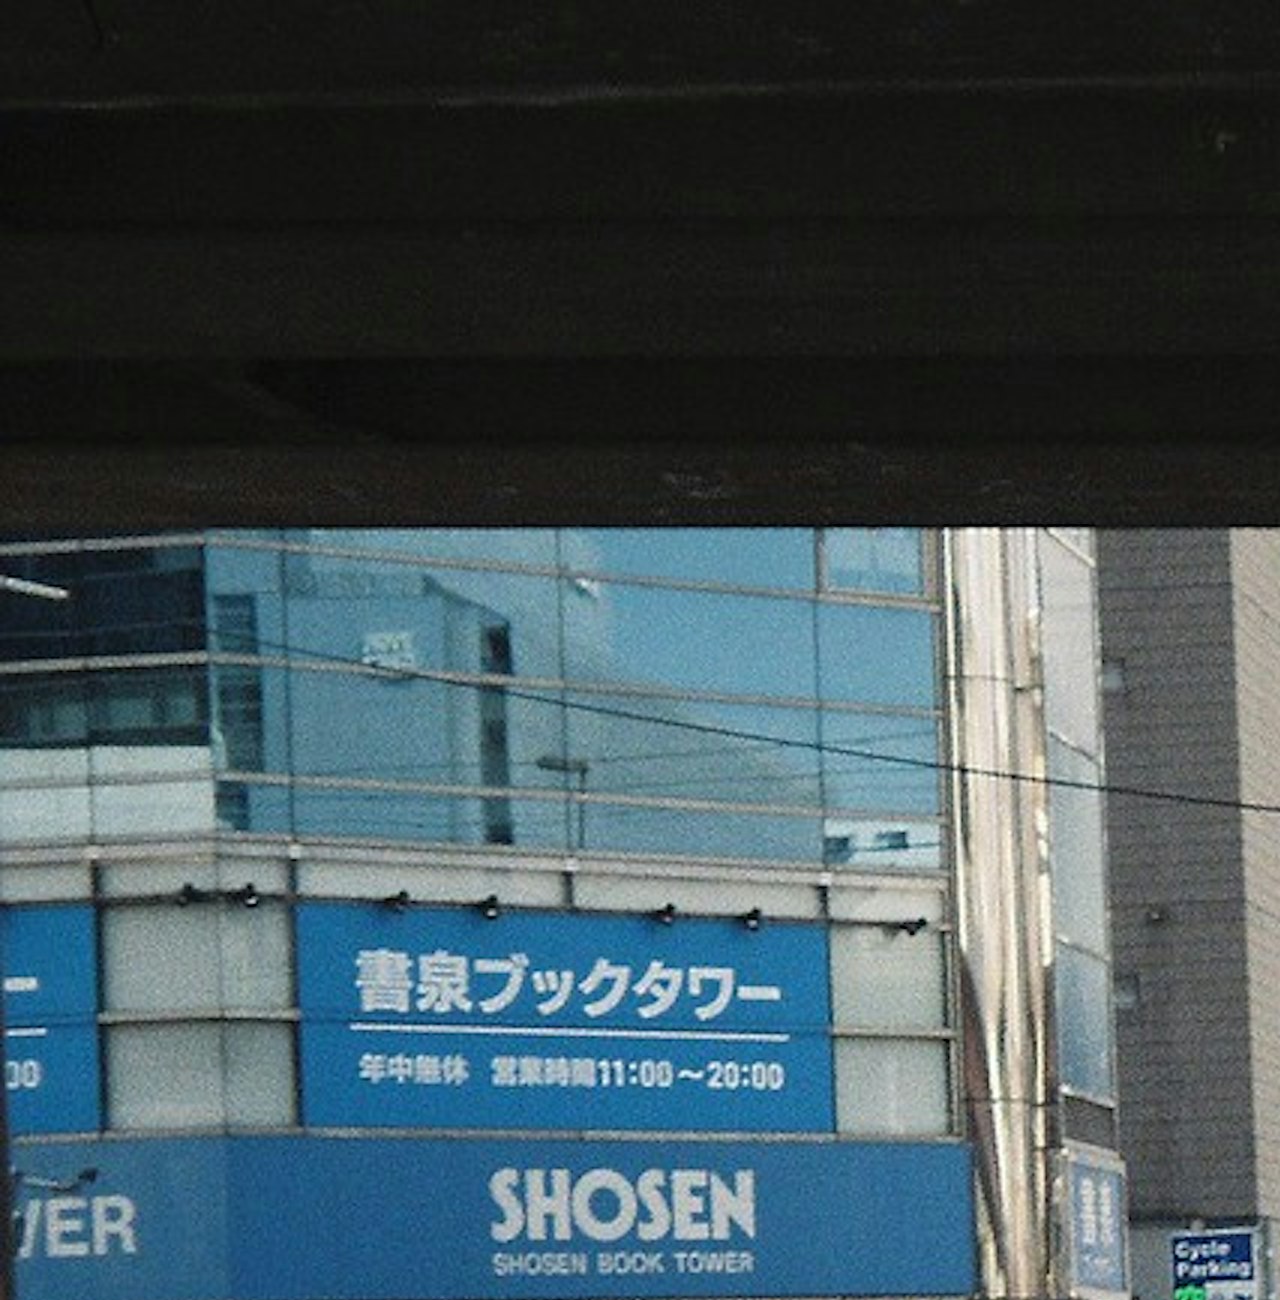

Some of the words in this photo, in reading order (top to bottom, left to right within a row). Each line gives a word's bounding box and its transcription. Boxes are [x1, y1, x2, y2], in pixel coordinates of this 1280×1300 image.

[356, 949, 782, 1021] 書泉ブックタワー
[358, 1053, 470, 1087] 年中無休
[488, 1168, 756, 1244] SHOSEN
[492, 1251, 588, 1277] SHOSEN
[597, 1251, 666, 1275] BOOK
[673, 1251, 756, 1274] TOWER
[1175, 1240, 1231, 1261] Cycle
[1176, 1259, 1253, 1279] Parking
